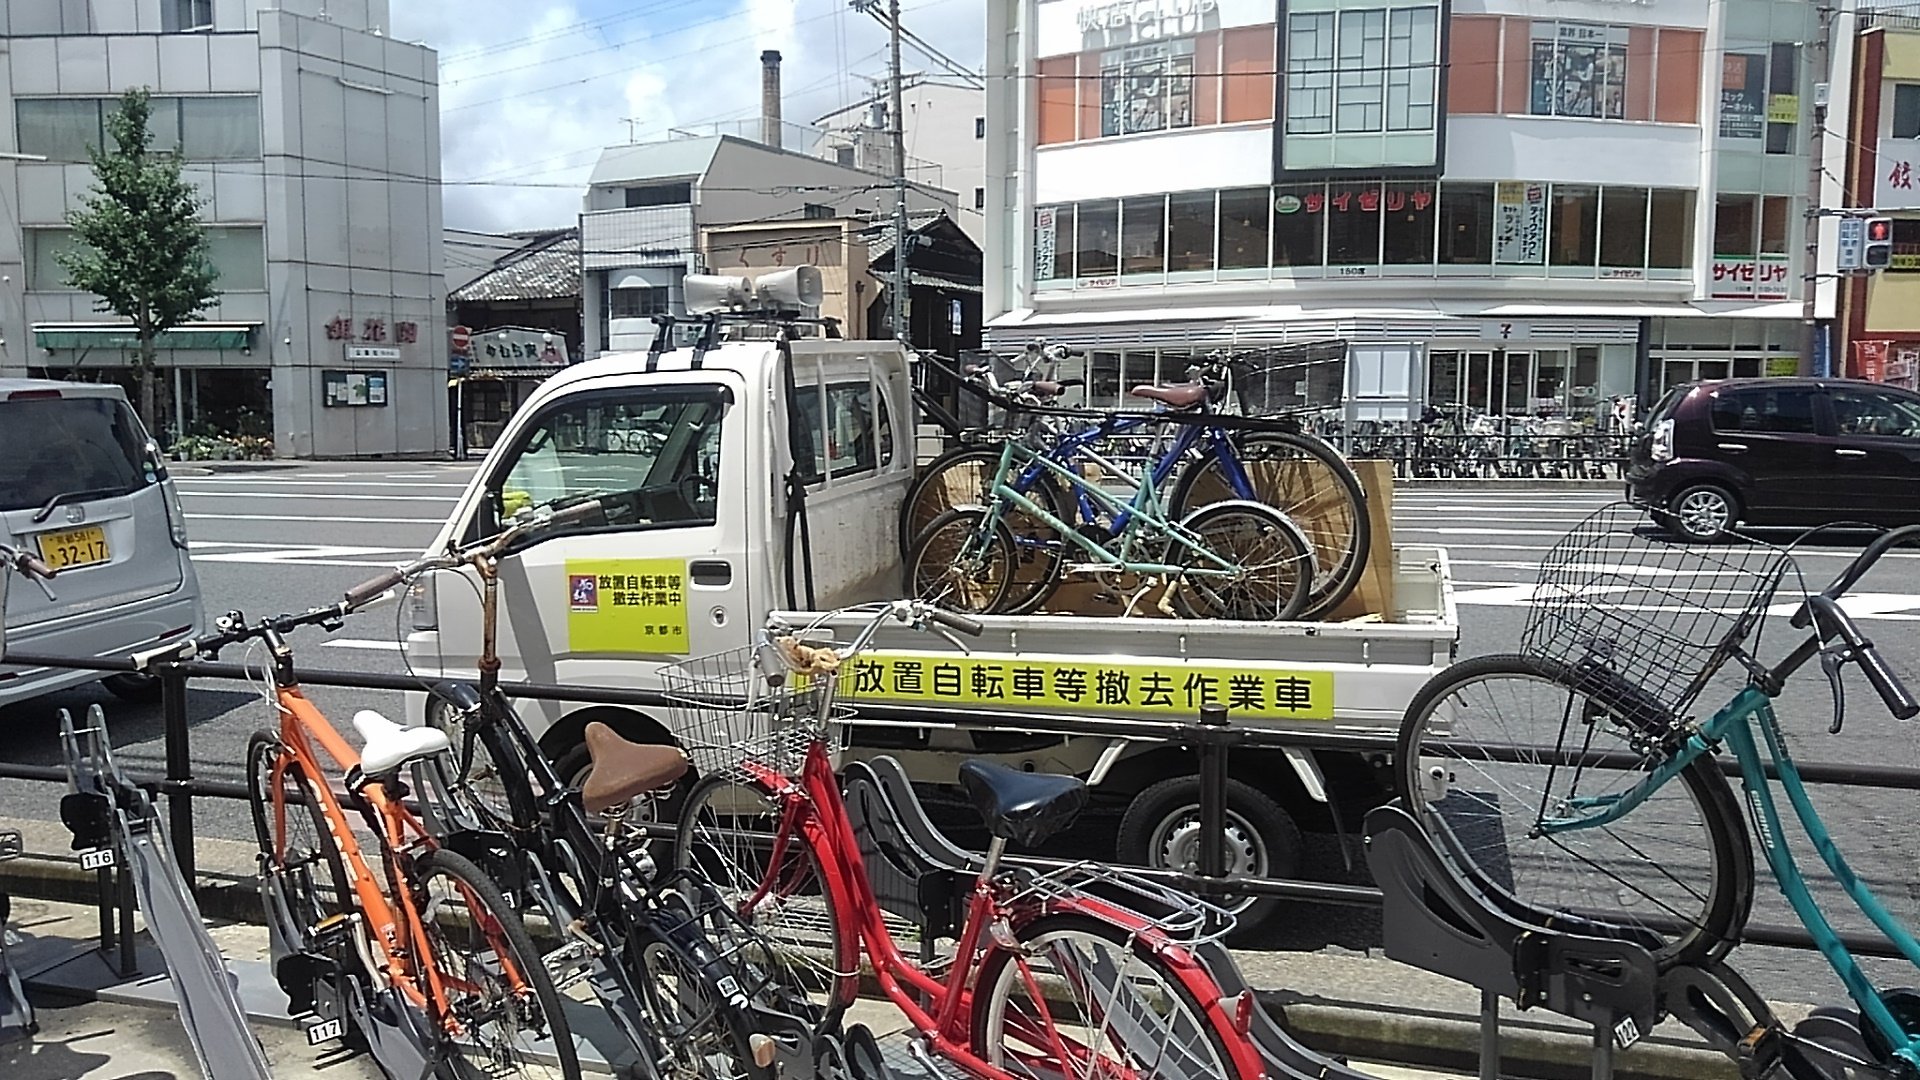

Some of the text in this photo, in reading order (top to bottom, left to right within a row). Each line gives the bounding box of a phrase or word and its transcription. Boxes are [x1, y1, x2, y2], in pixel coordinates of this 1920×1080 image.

[1305, 189, 1432, 213] サイゼリヤ
[1529, 206, 1538, 259] テイクアウト
[739, 245, 819, 268] くすり
[1712, 263, 1787, 282] サイゼリヤ
[57, 541, 106, 566] 32-17
[599, 575, 681, 590] 放置自転車等
[613, 592, 681, 606] 撤去作業中
[645, 625, 682, 635] 京都市
[854, 659, 1313, 713] 放置自転車等撤去作業車
[85, 852, 111, 867] 116
[312, 1022, 337, 1040] 117
[1618, 1021, 1637, 1044] 122
